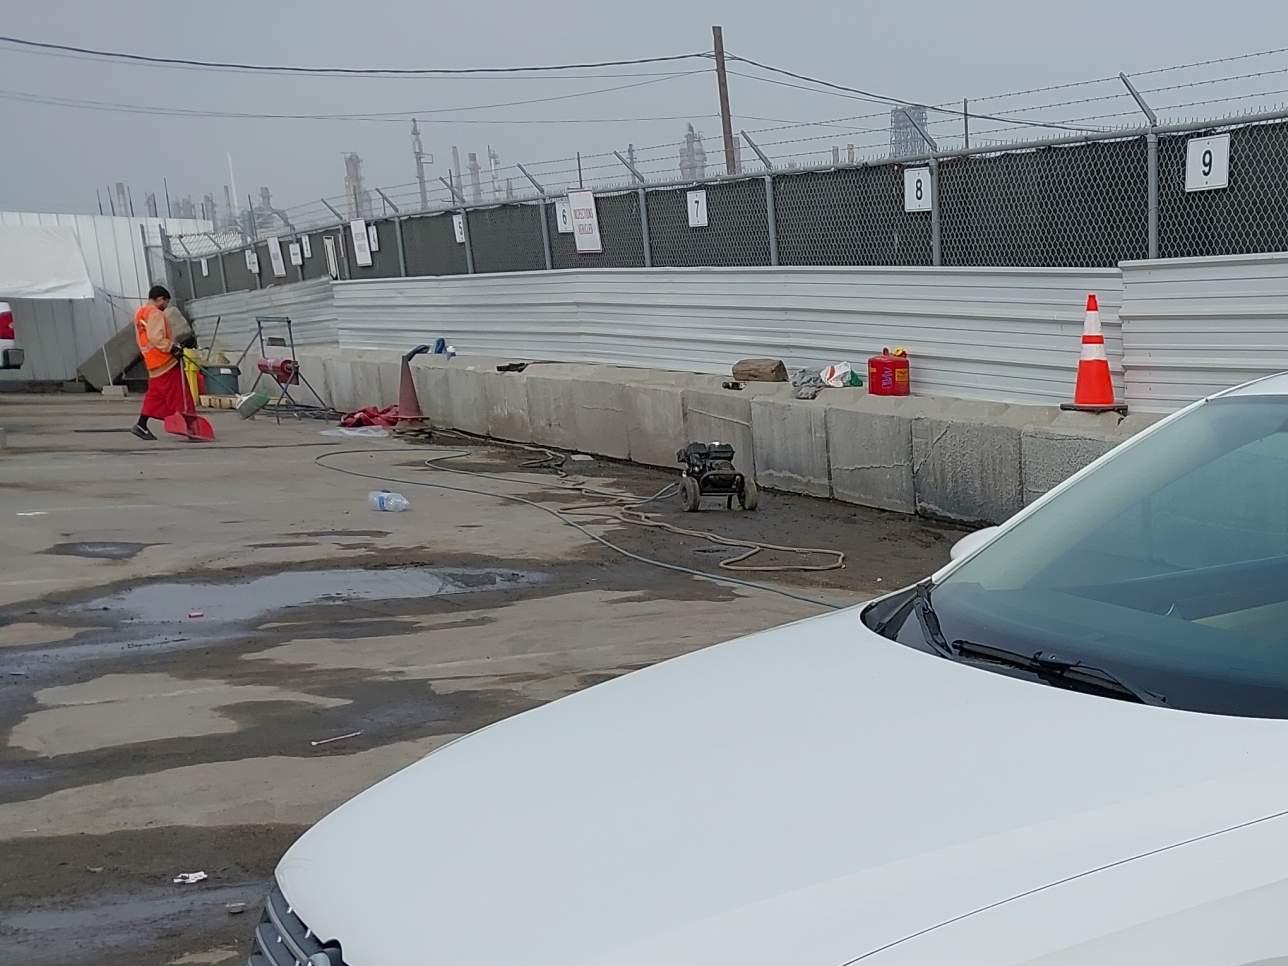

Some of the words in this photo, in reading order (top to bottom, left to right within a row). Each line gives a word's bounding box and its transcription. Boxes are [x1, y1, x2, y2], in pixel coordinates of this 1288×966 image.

[1201, 149, 1213, 177] 9
[915, 178, 923, 201] 8
[562, 208, 567, 225] 6
[694, 200, 700, 218] 7
